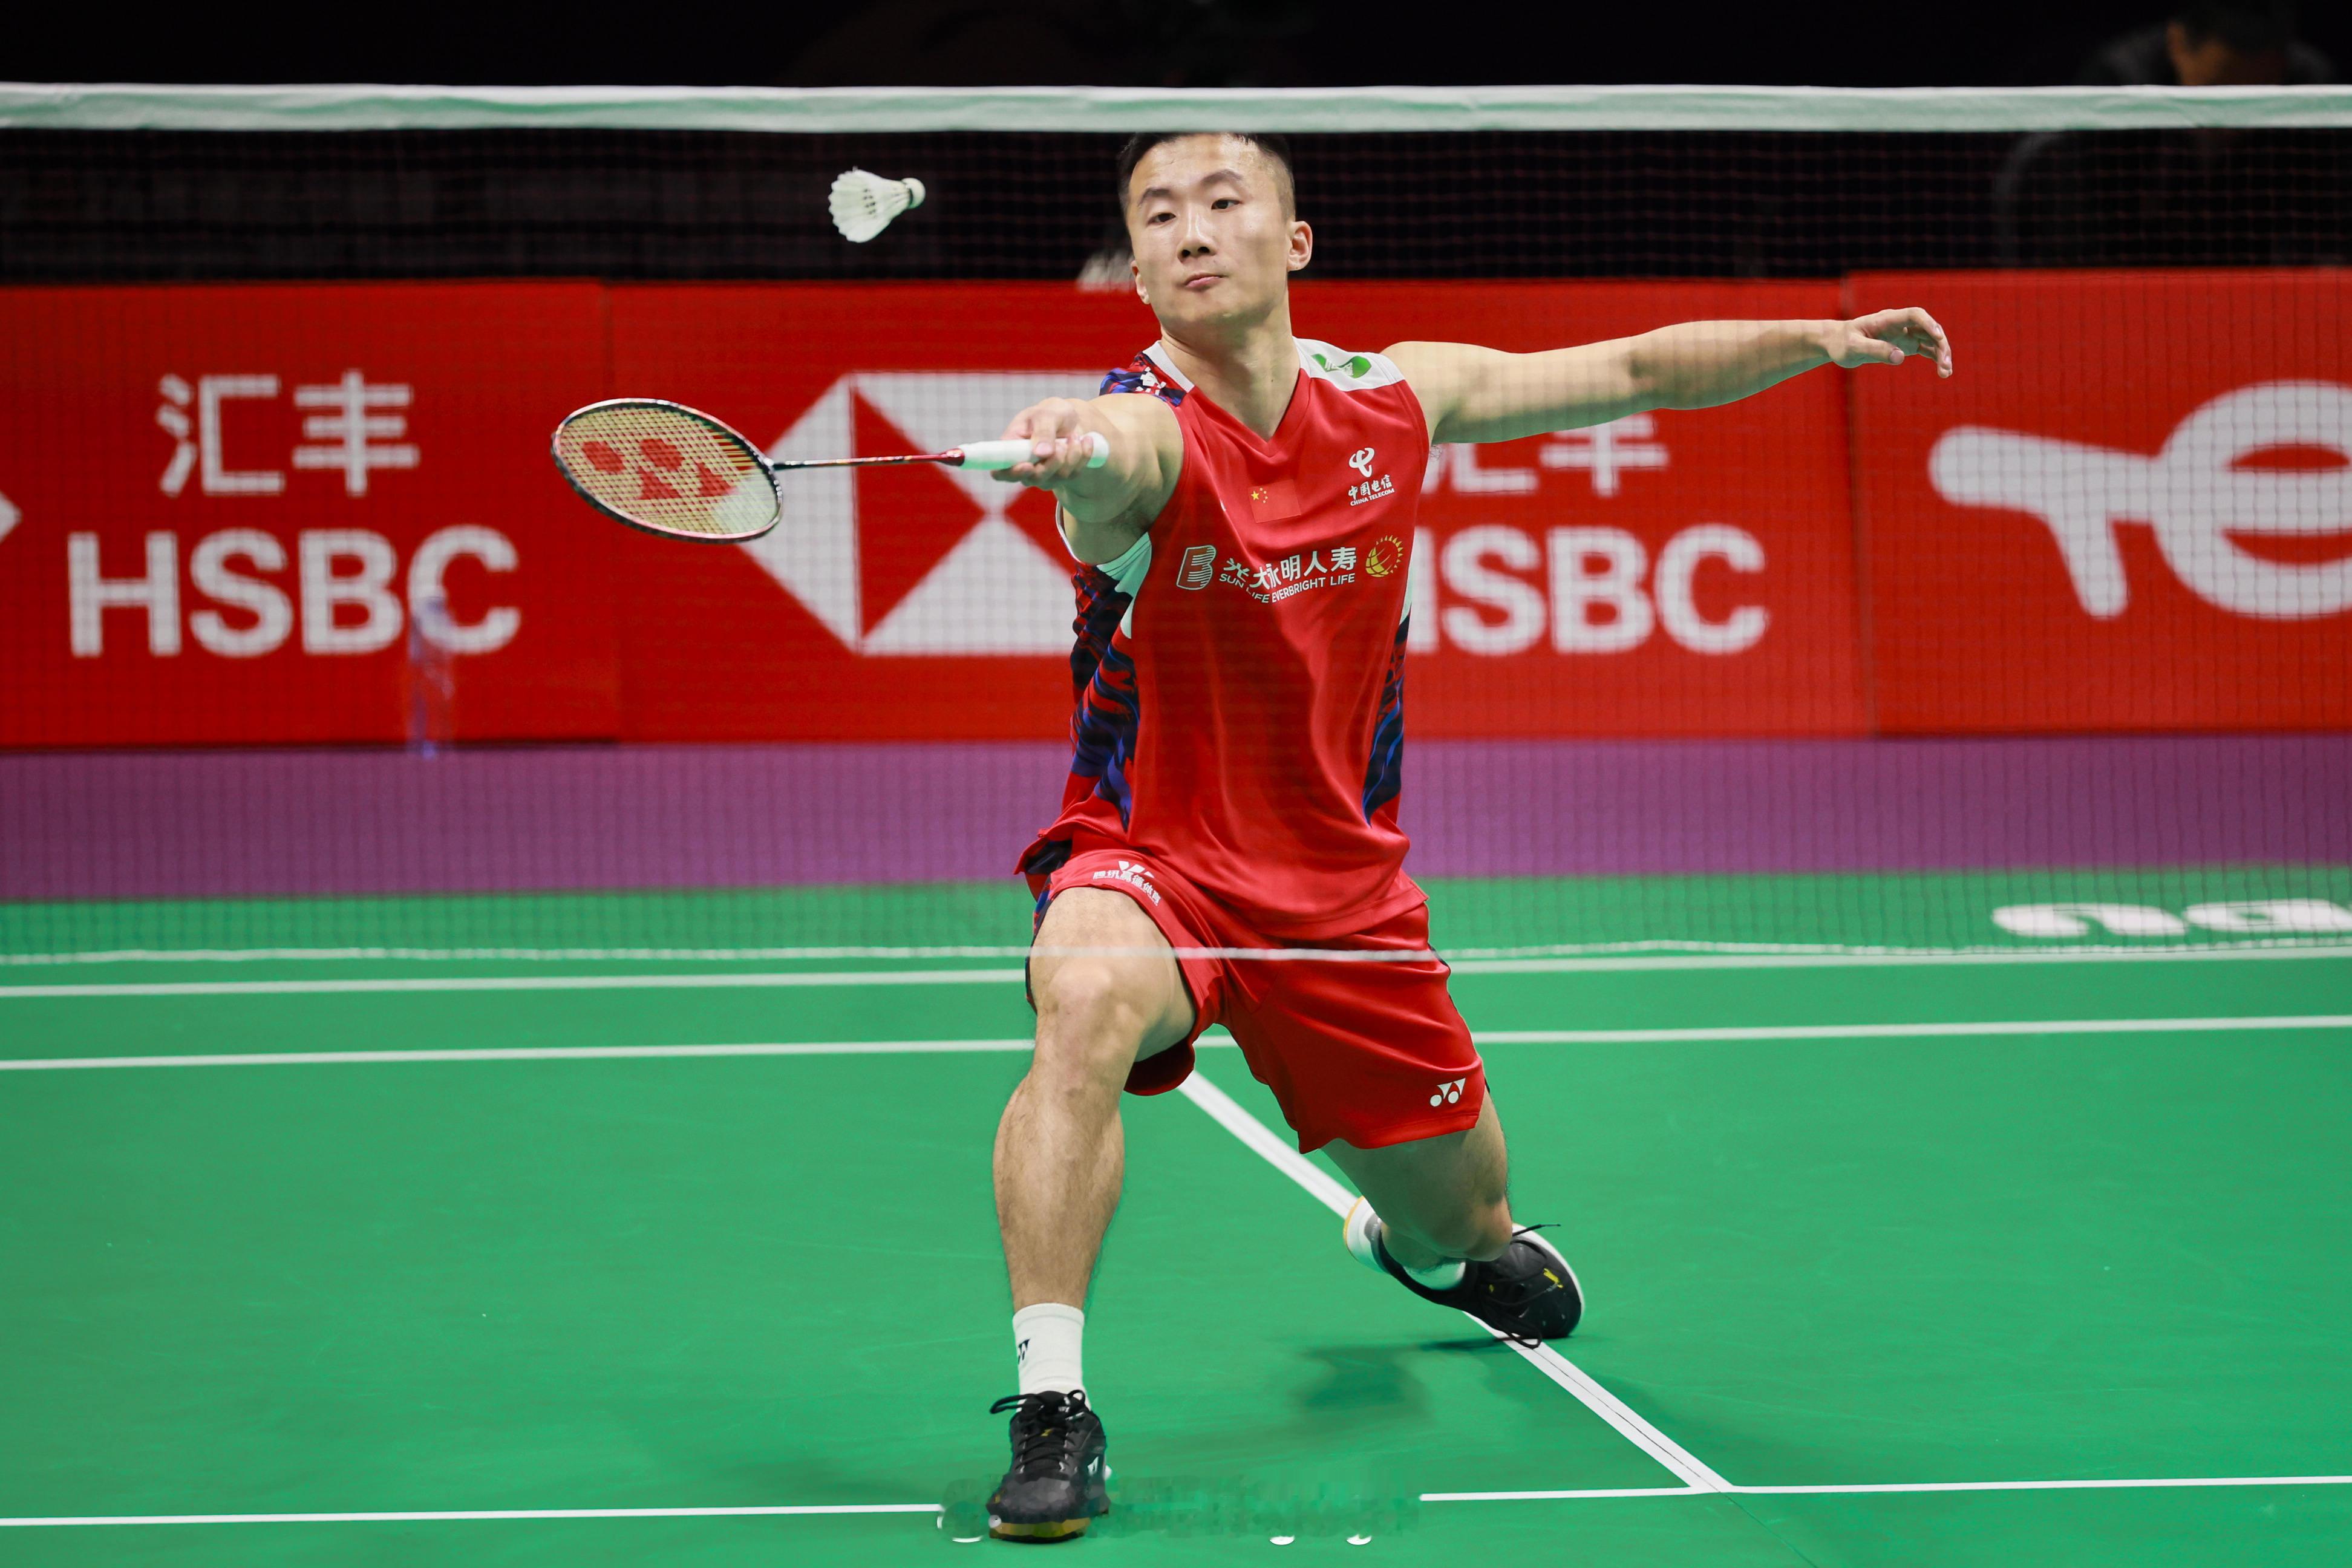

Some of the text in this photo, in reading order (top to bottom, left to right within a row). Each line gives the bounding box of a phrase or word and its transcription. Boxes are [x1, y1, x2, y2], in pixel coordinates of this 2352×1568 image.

[156, 368, 420, 498] 汇丰
[1348, 474, 1392, 500] 中国电信
[1350, 488, 1395, 506] CHINA TELECOM
[1223, 547, 1357, 590] 光大永明人寿
[68, 524, 521, 658] HSBC
[1219, 573, 1356, 603] SUN LIFE EVERBRIGHT LIFE
